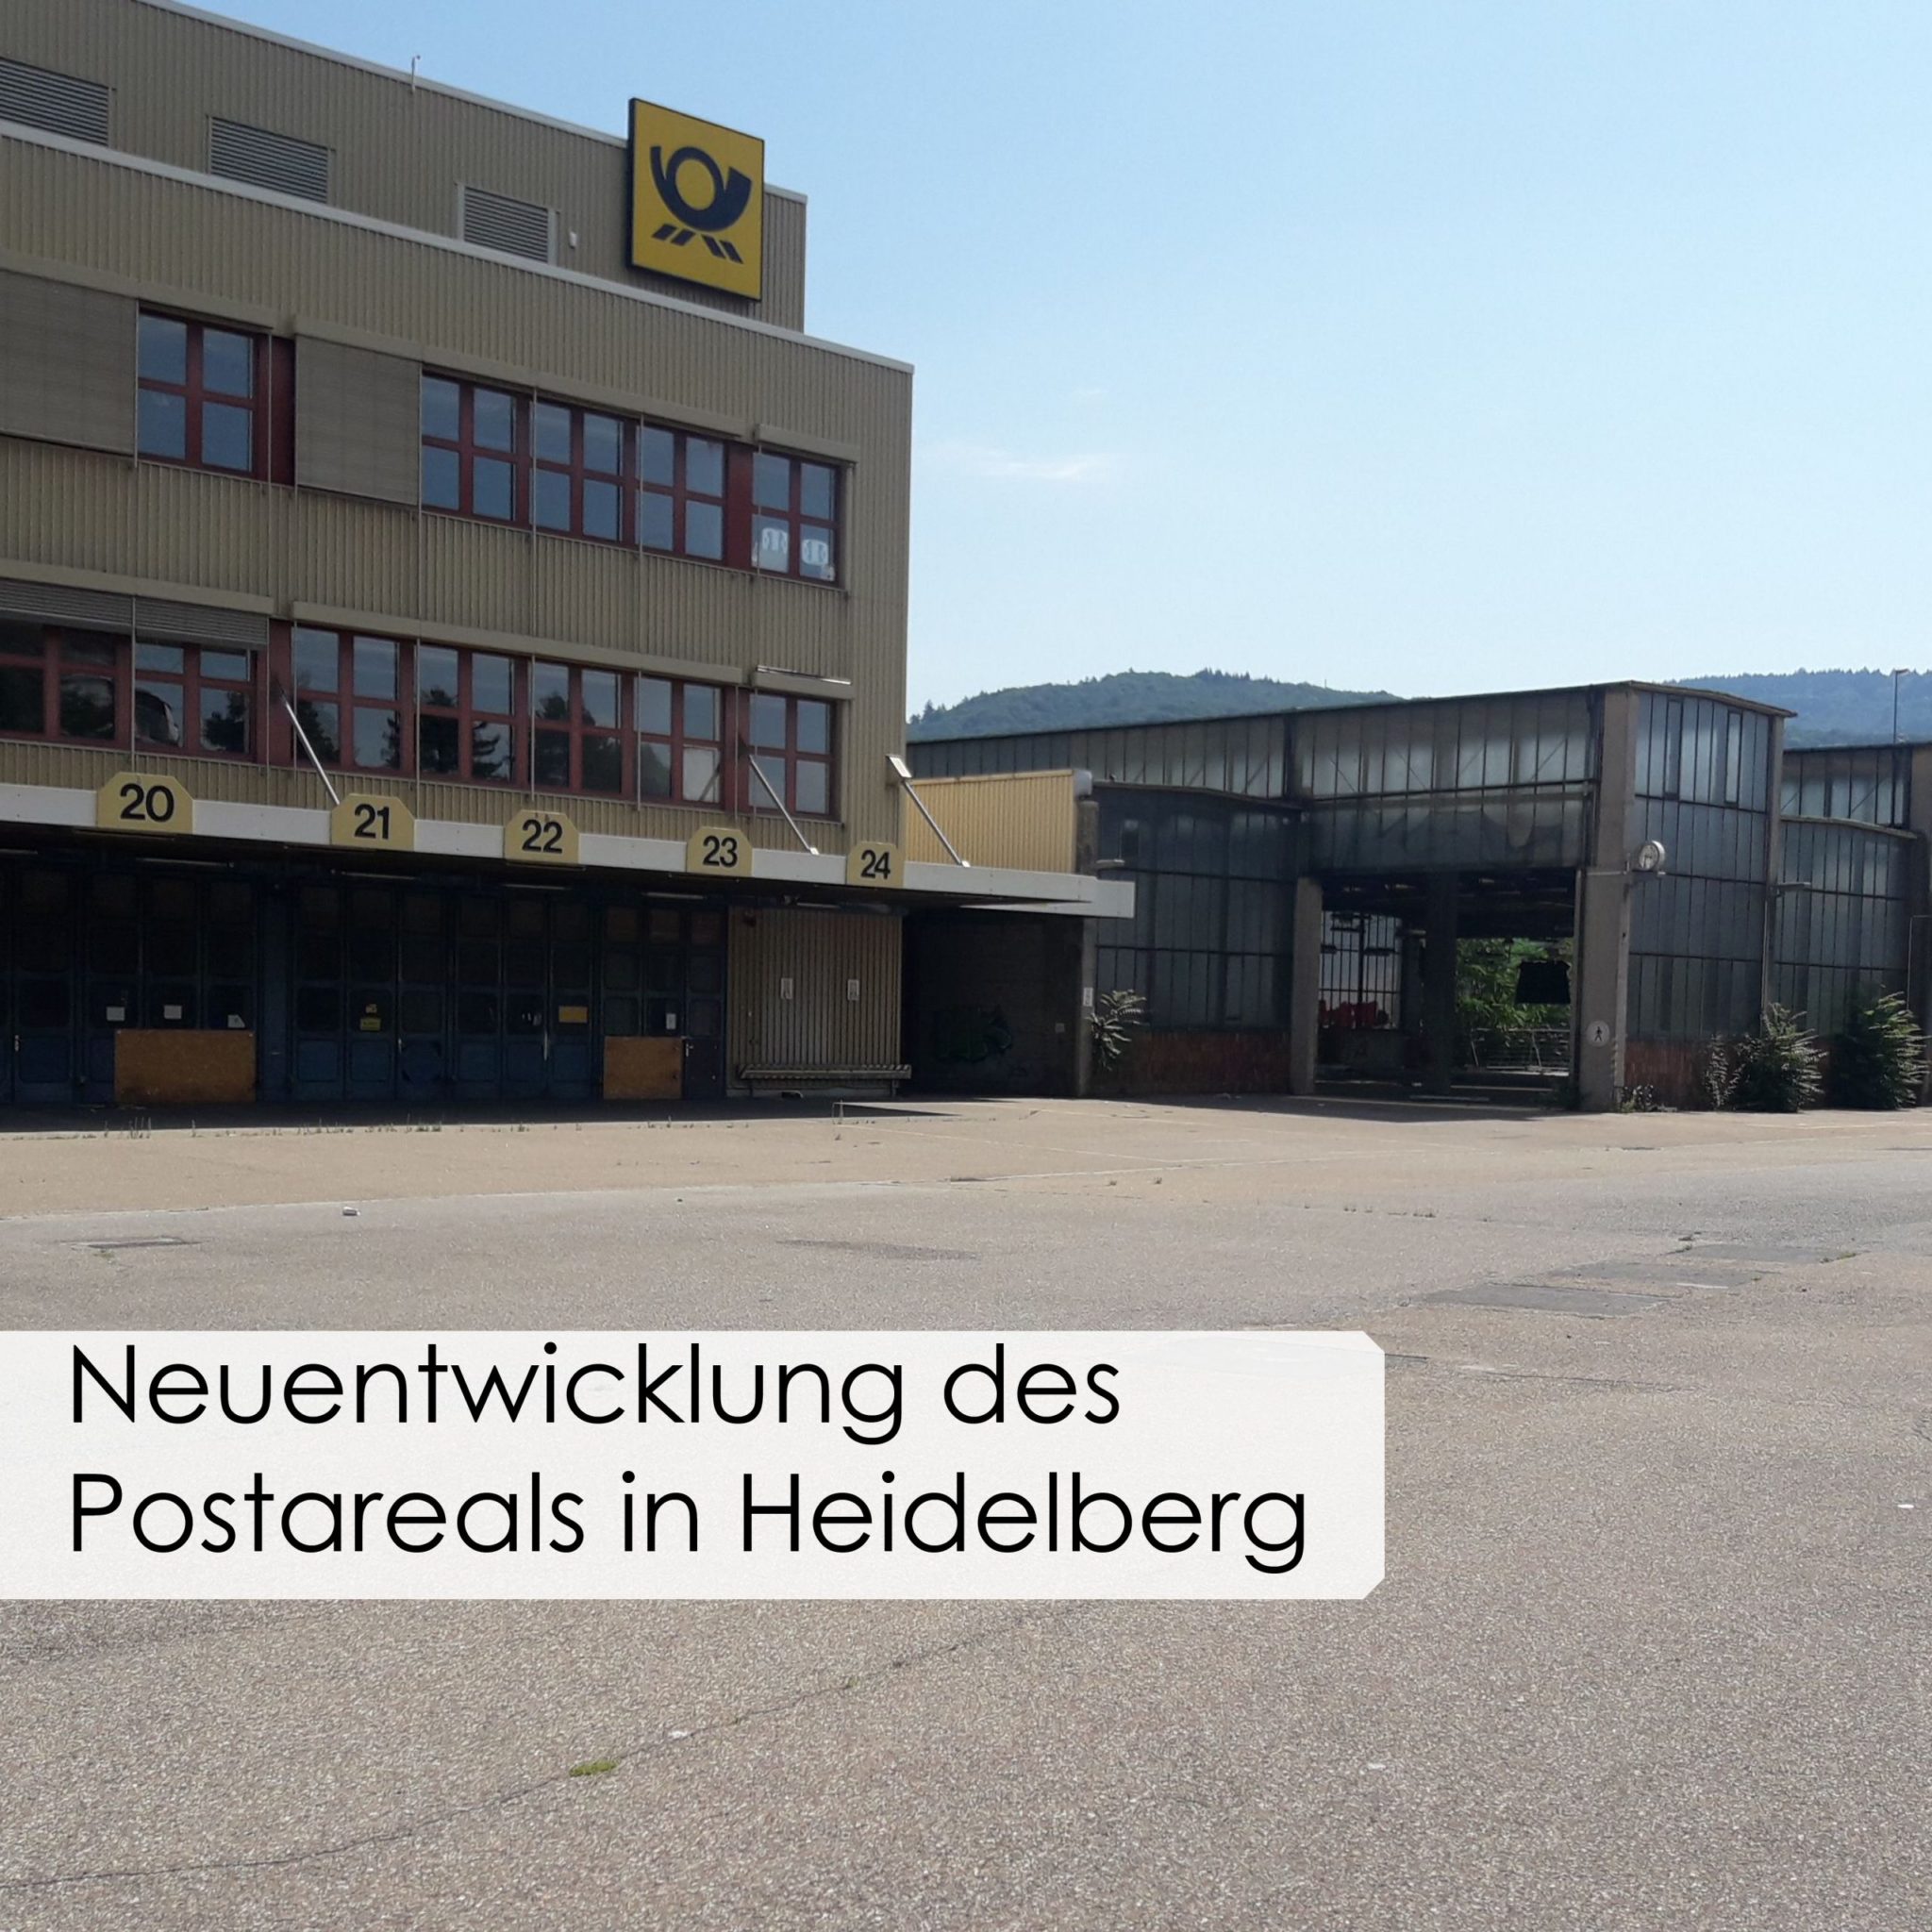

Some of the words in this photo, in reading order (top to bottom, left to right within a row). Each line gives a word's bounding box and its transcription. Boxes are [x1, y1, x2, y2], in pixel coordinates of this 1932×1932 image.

[120, 783, 175, 823] 20
[354, 803, 390, 841] 21
[522, 819, 563, 855] 22
[702, 835, 738, 868] 23
[860, 849, 891, 880] 24
